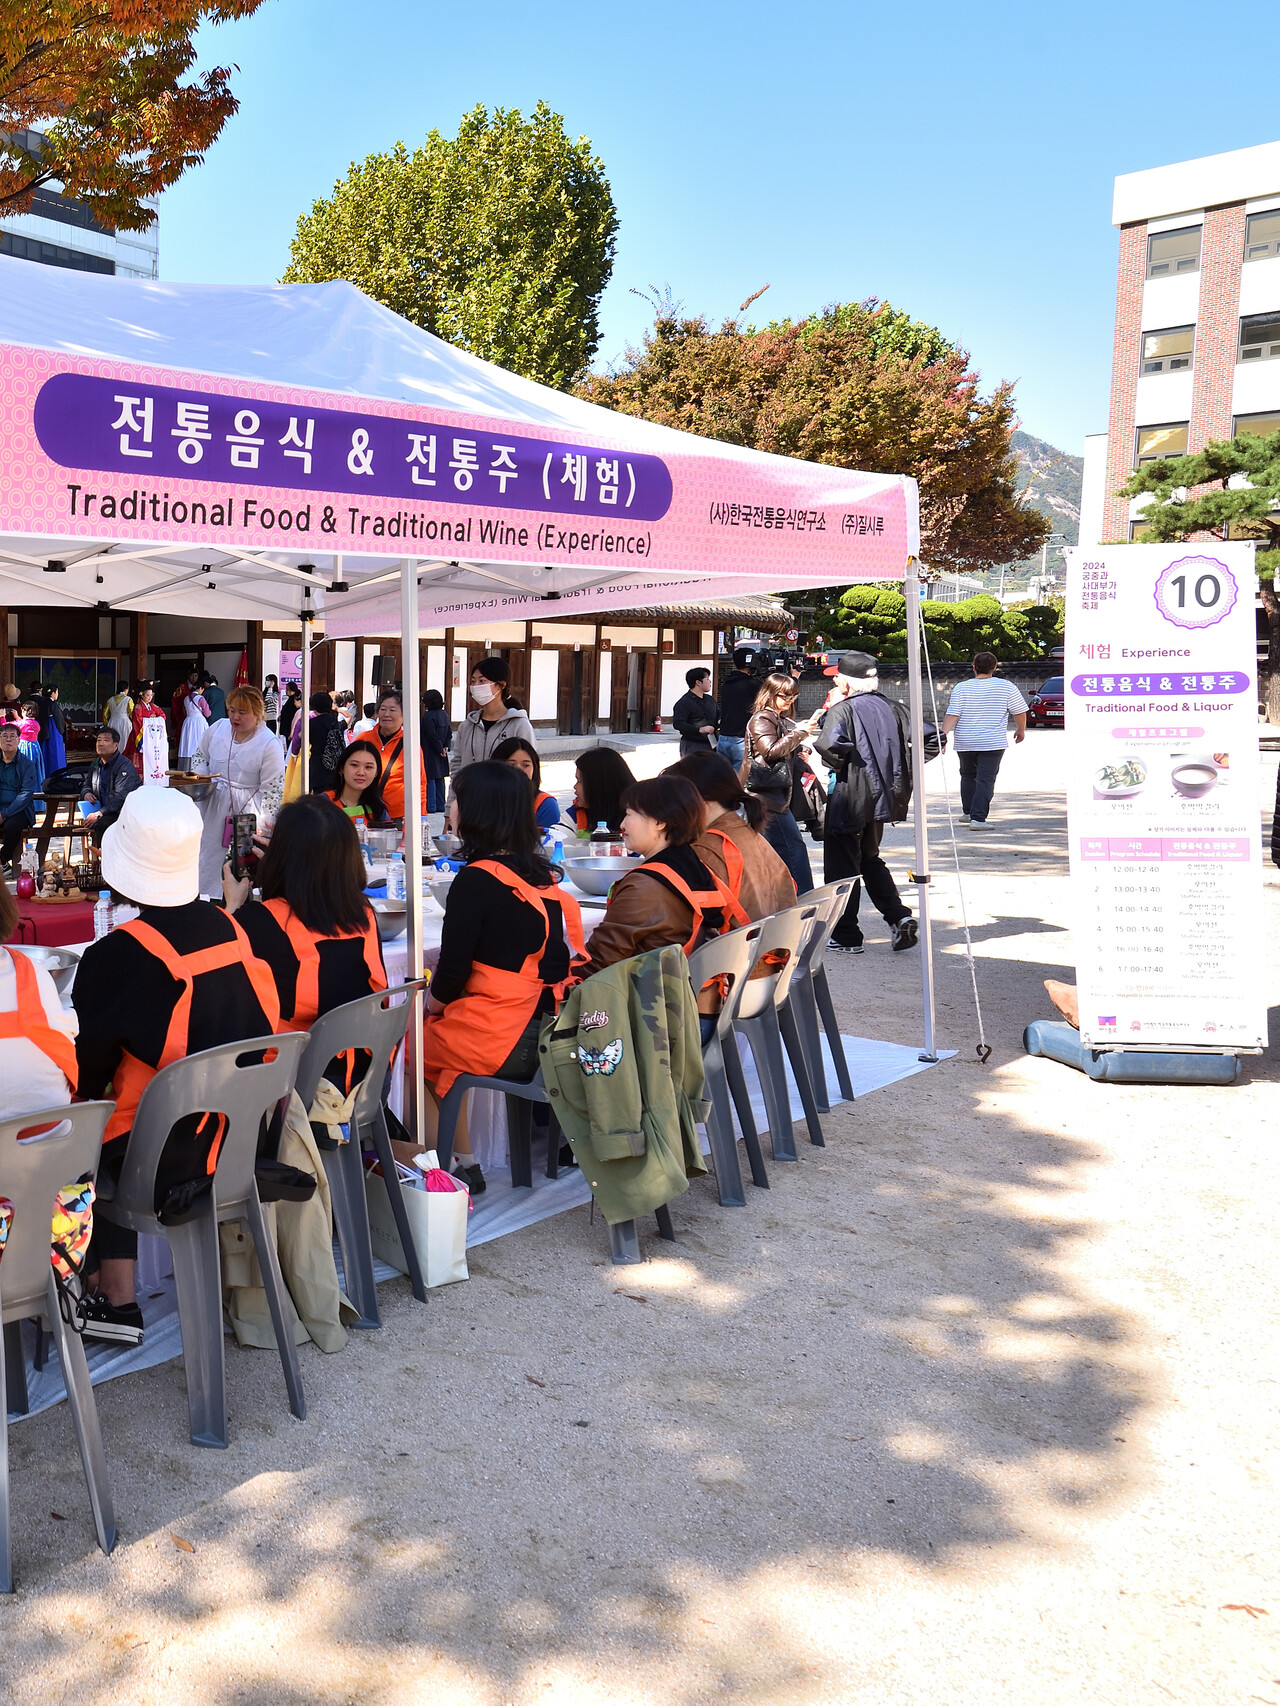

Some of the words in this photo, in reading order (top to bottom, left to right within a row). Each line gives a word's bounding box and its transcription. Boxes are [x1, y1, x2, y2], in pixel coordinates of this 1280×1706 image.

[111, 394, 315, 474] 전통음식
[346, 428, 375, 475] &
[405, 433, 518, 493] 전통주
[542, 452, 637, 507] (체험)
[67, 484, 233, 526] Traditional
[243, 499, 311, 531] Food
[320, 505, 337, 533] &
[348, 507, 471, 542] Traditional
[479, 518, 528, 547] Wine
[537, 522, 651, 557] (Experience)
[709, 501, 827, 532] (사)한국전통음식연구소
[841, 513, 885, 536] (주)질시루
[1082, 562, 1106, 570] 2024
[1082, 571, 1108, 580] 궁중과
[1081, 581, 1117, 590] 사대부가
[1170, 574, 1221, 608] 10
[1081, 591, 1117, 600] 전통음식
[1081, 602, 1099, 610] 축제
[1079, 644, 1111, 659] 체험
[1122, 648, 1191, 659] Experience
[1082, 676, 1151, 693] 전통음식
[1159, 677, 1172, 691] &
[1181, 675, 1236, 691] 전통주
[1085, 703, 1146, 713] Traditional
[1149, 702, 1178, 712] Food
[1182, 703, 1190, 711] &
[1194, 702, 1234, 713] Liquor
